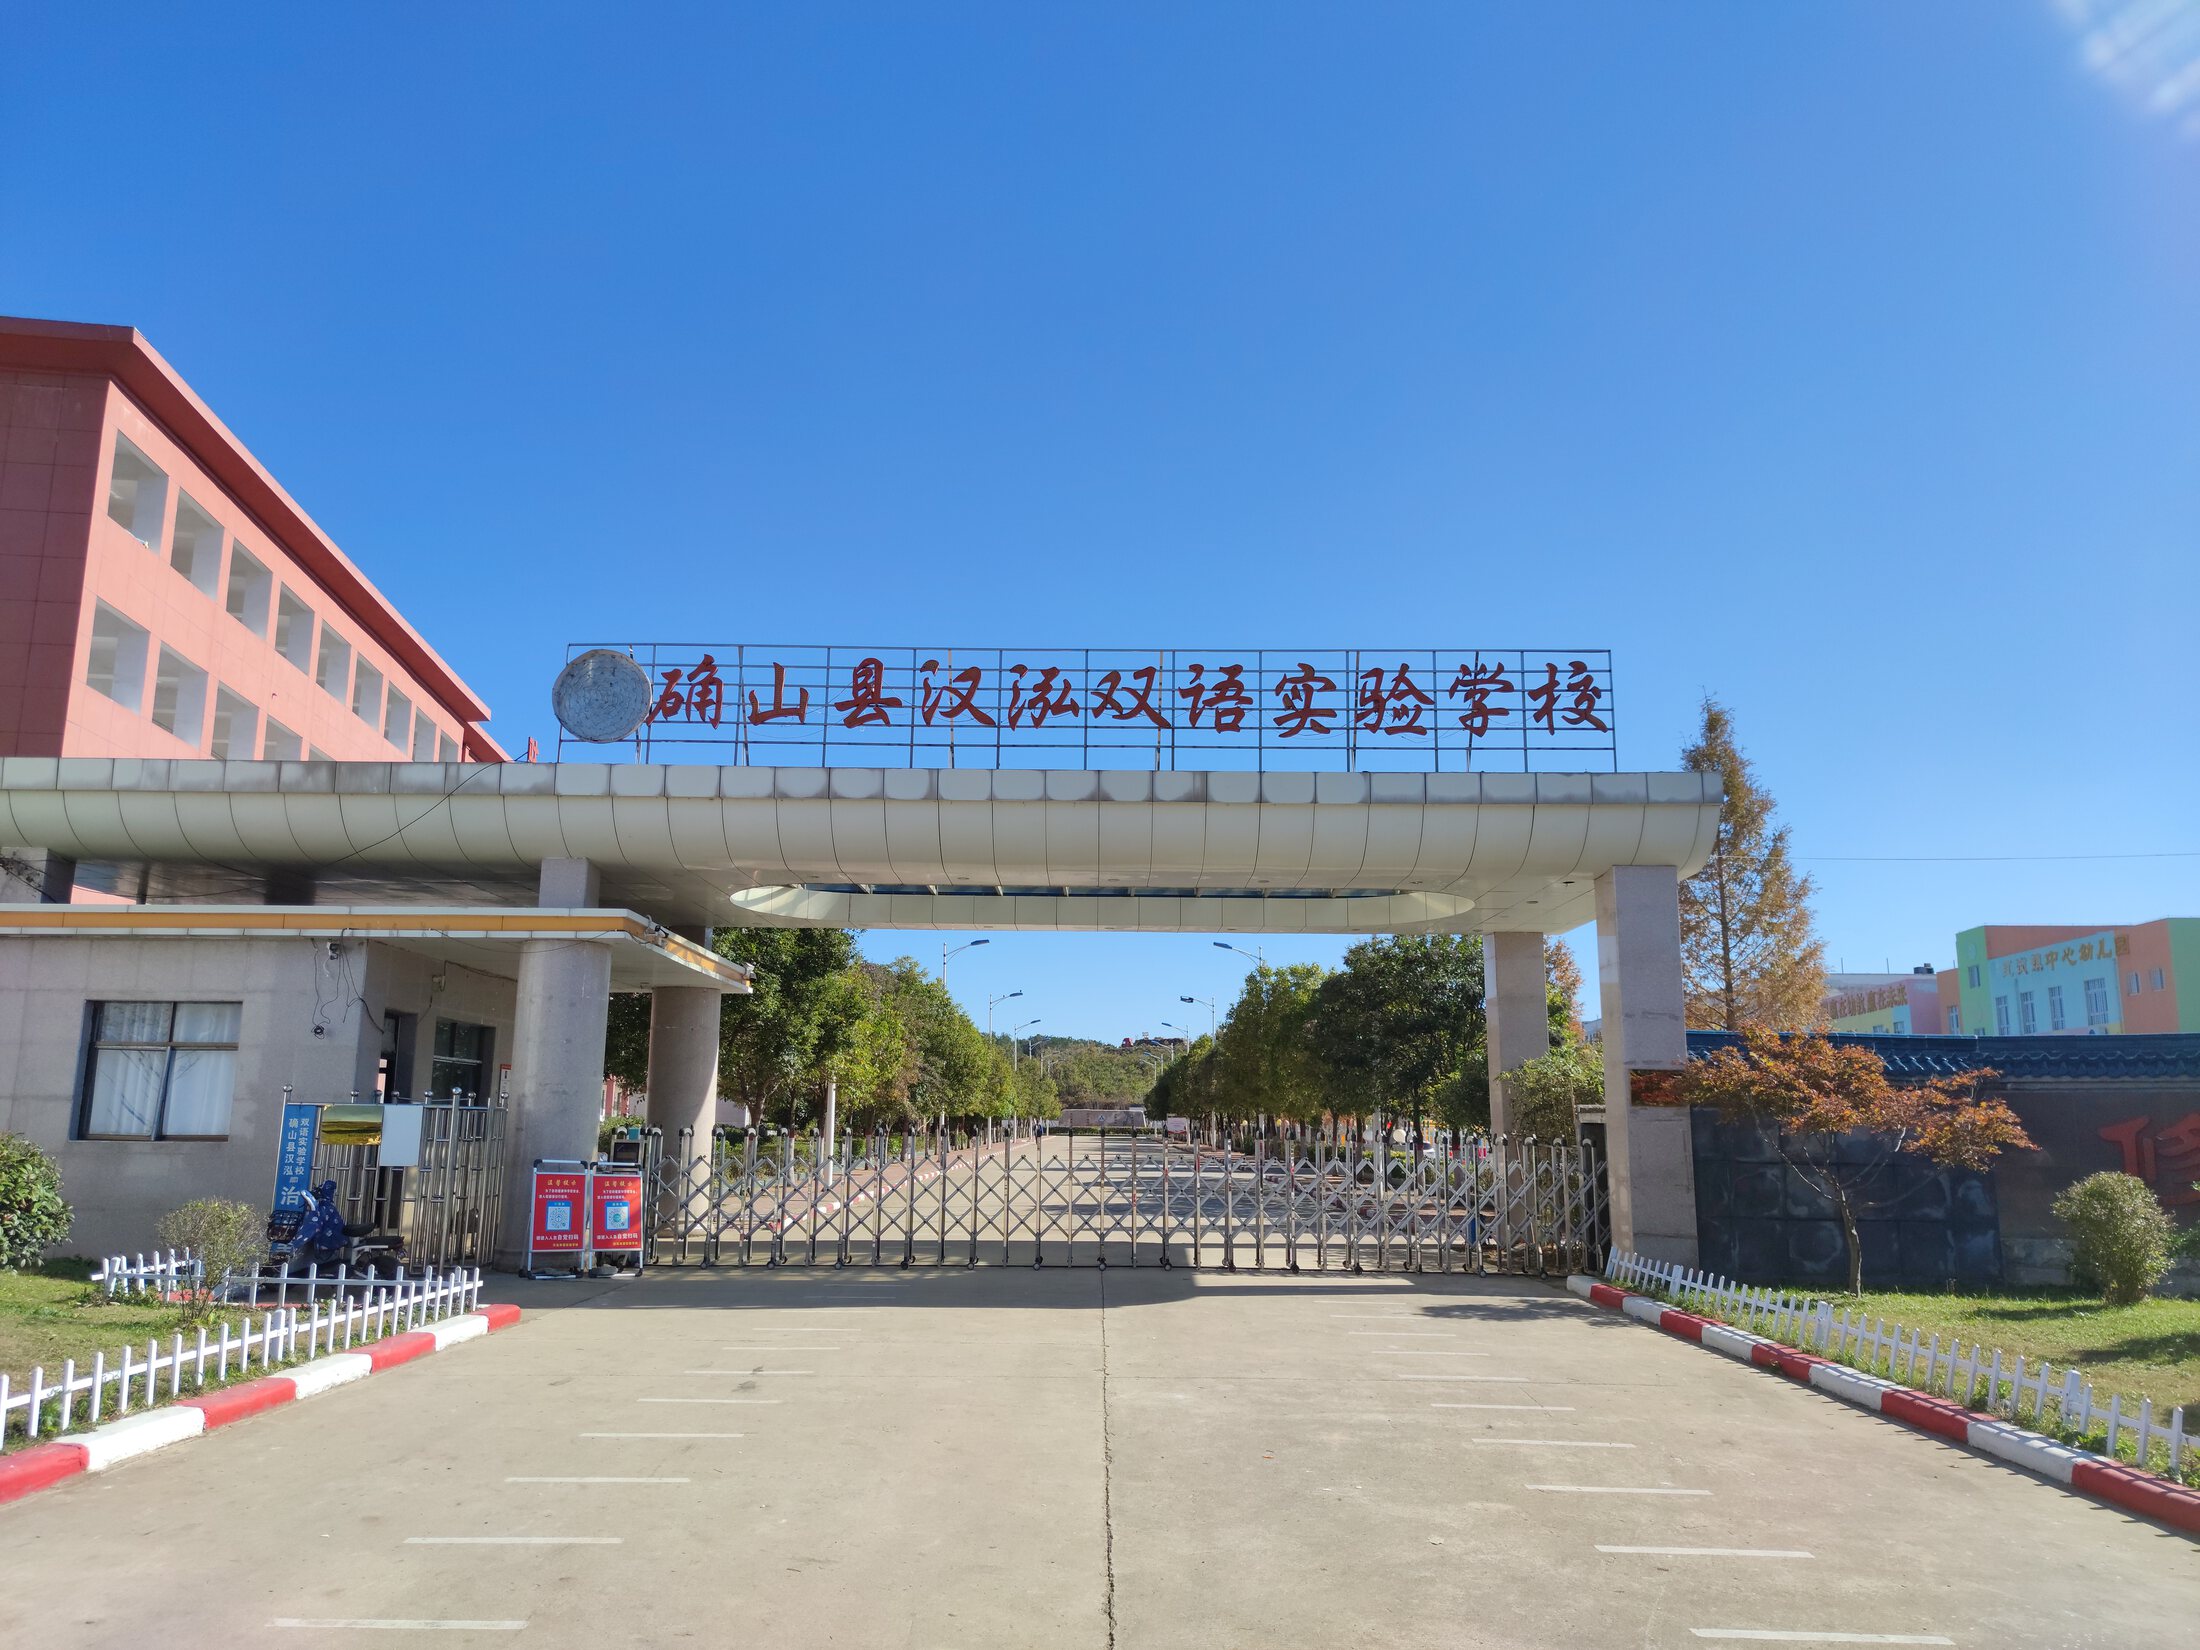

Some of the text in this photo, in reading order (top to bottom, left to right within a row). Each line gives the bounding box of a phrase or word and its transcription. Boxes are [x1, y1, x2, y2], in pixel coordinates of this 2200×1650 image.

[646, 654, 1609, 738] 确山县汉泓双语实验学校
[282, 1117, 299, 1176] 确山县汉泓
[294, 1117, 310, 1176] 双语实验学校
